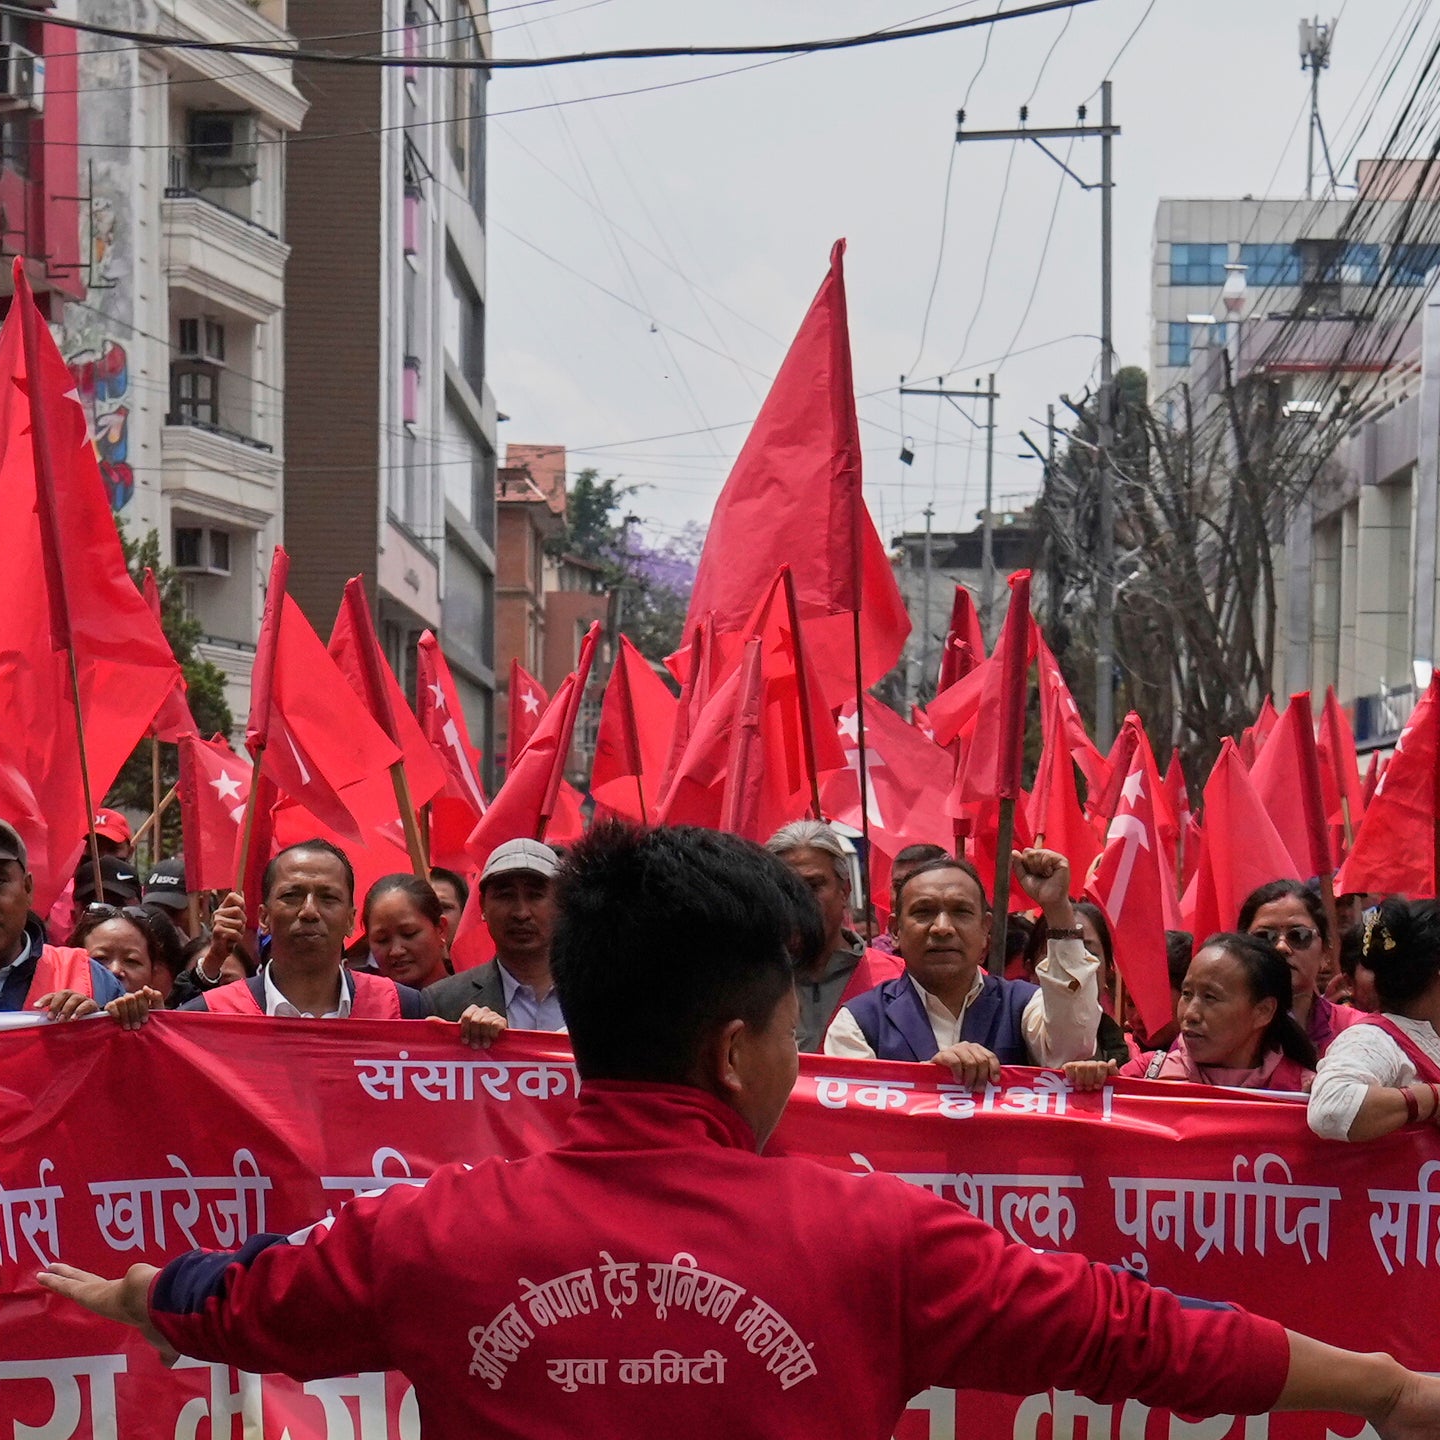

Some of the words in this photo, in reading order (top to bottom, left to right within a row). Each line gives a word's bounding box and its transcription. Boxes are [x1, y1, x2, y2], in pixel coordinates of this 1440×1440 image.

[814, 1075, 915, 1110] एक
[88, 1147, 272, 1252] खारेजी
[468, 1302, 535, 1390] अखिल
[518, 1268, 599, 1327] नेपाल
[599, 1251, 640, 1319] ट्रेड
[647, 1252, 746, 1325] यूनियन
[734, 1296, 818, 1391] महासंघ
[546, 1358, 608, 1393] युवा
[619, 1350, 727, 1385] कमिटी
